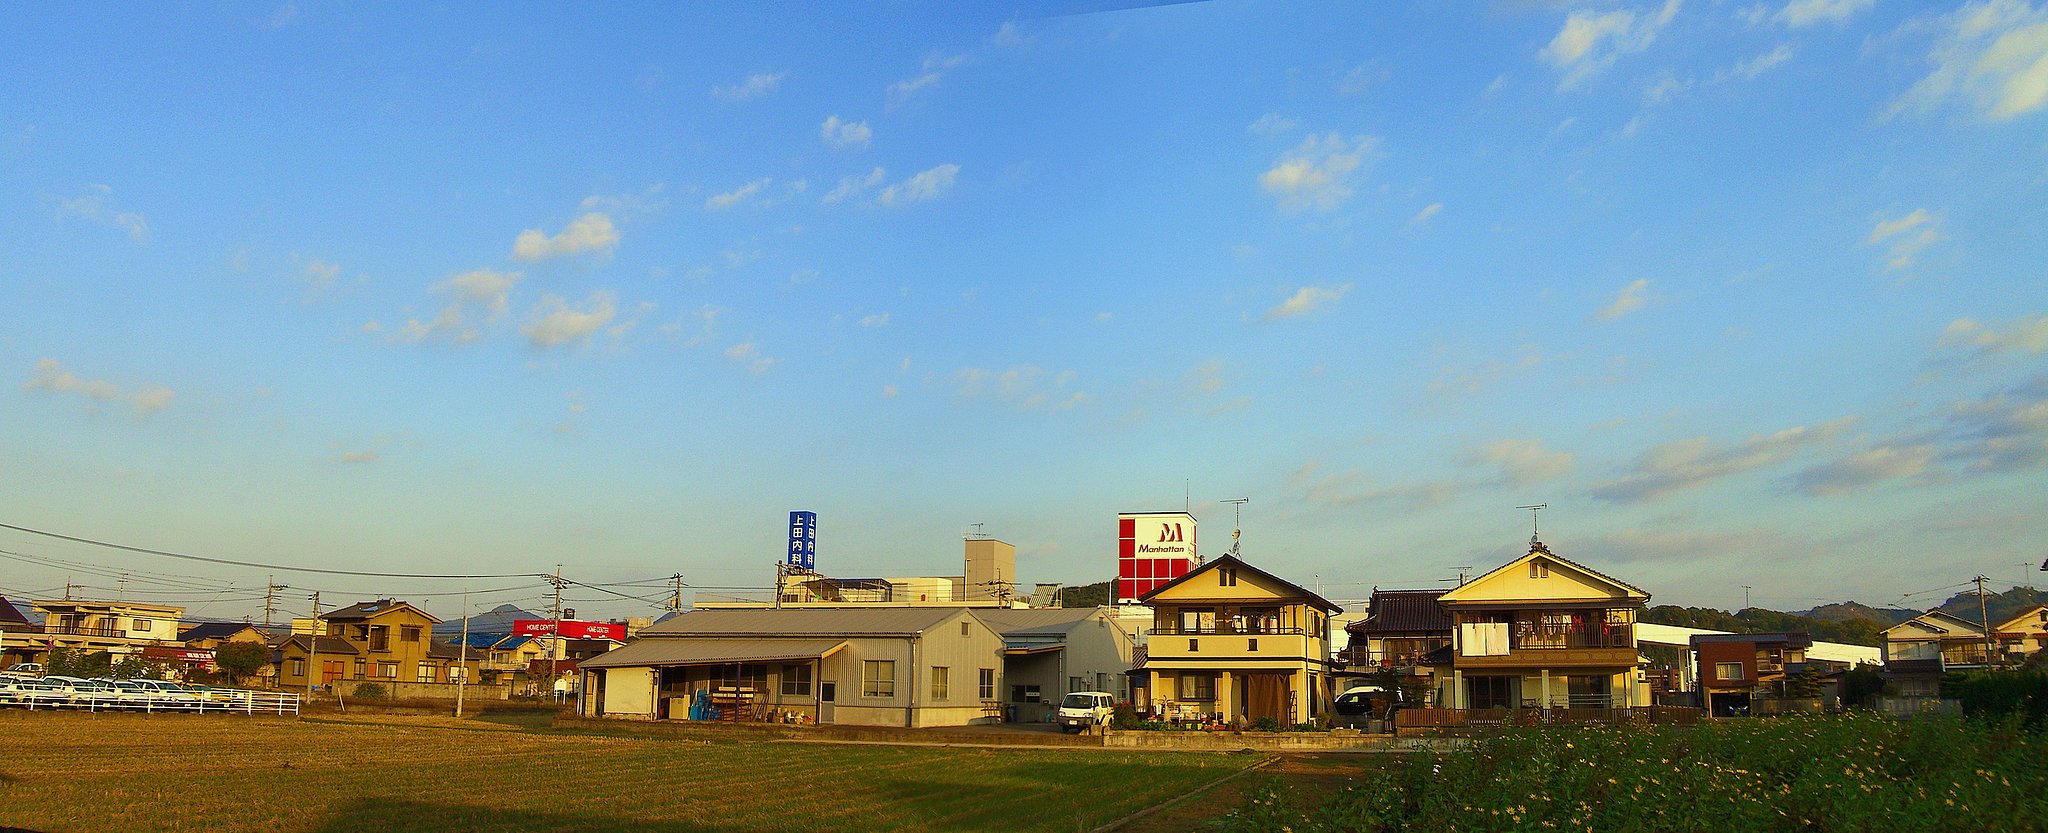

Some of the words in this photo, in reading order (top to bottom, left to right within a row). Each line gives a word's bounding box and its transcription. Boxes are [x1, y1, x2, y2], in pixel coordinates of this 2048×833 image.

[792, 514, 803, 564] 上田内科
[807, 515, 815, 565] 上田内科
[1138, 544, 1185, 553] Manhattan
